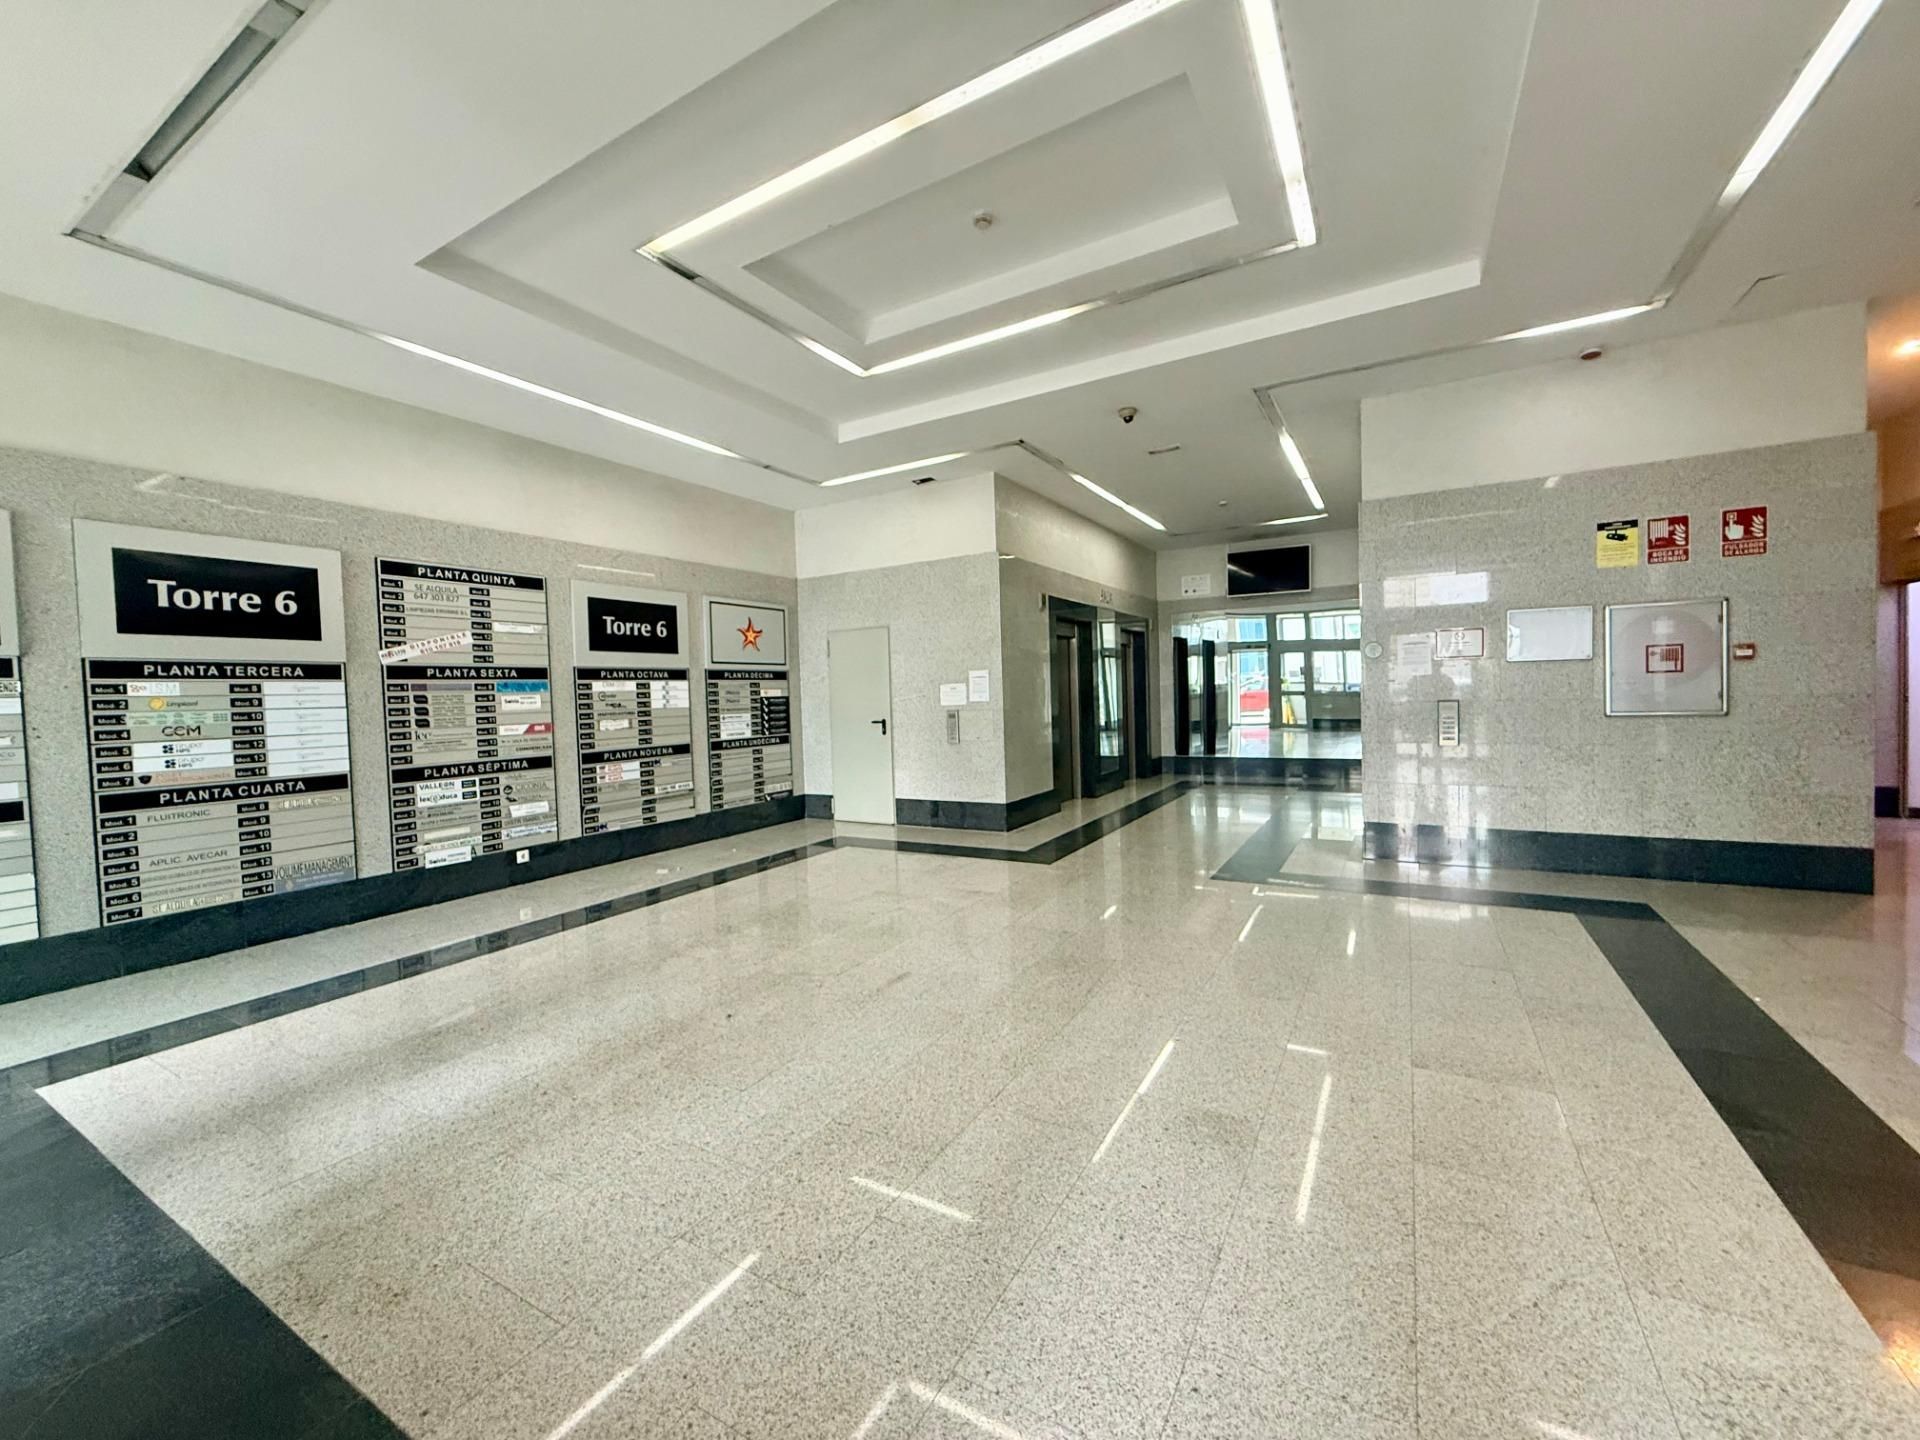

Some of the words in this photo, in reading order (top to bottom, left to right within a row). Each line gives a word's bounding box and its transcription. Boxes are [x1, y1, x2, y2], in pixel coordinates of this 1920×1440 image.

[418, 566, 469, 581] PLANTA
[472, 573, 516, 586] QUINTA
[146, 578, 262, 614] Torre
[274, 590, 298, 615] 6
[602, 616, 651, 636] Torre
[656, 620, 668, 638] 6
[144, 664, 219, 676] PLANTA
[224, 666, 304, 677] TERCERA
[427, 669, 477, 678] PLANTA
[480, 668, 518, 678] SEXTA
[604, 751, 637, 760] PLANTA
[640, 748, 673, 756] NOVENA
[424, 764, 474, 778] PLANTA
[160, 788, 234, 804] PLANTA
[238, 781, 306, 796] CUARTA
[147, 809, 211, 822] FLUITRONIC
[186, 850, 228, 862] AVECAR
